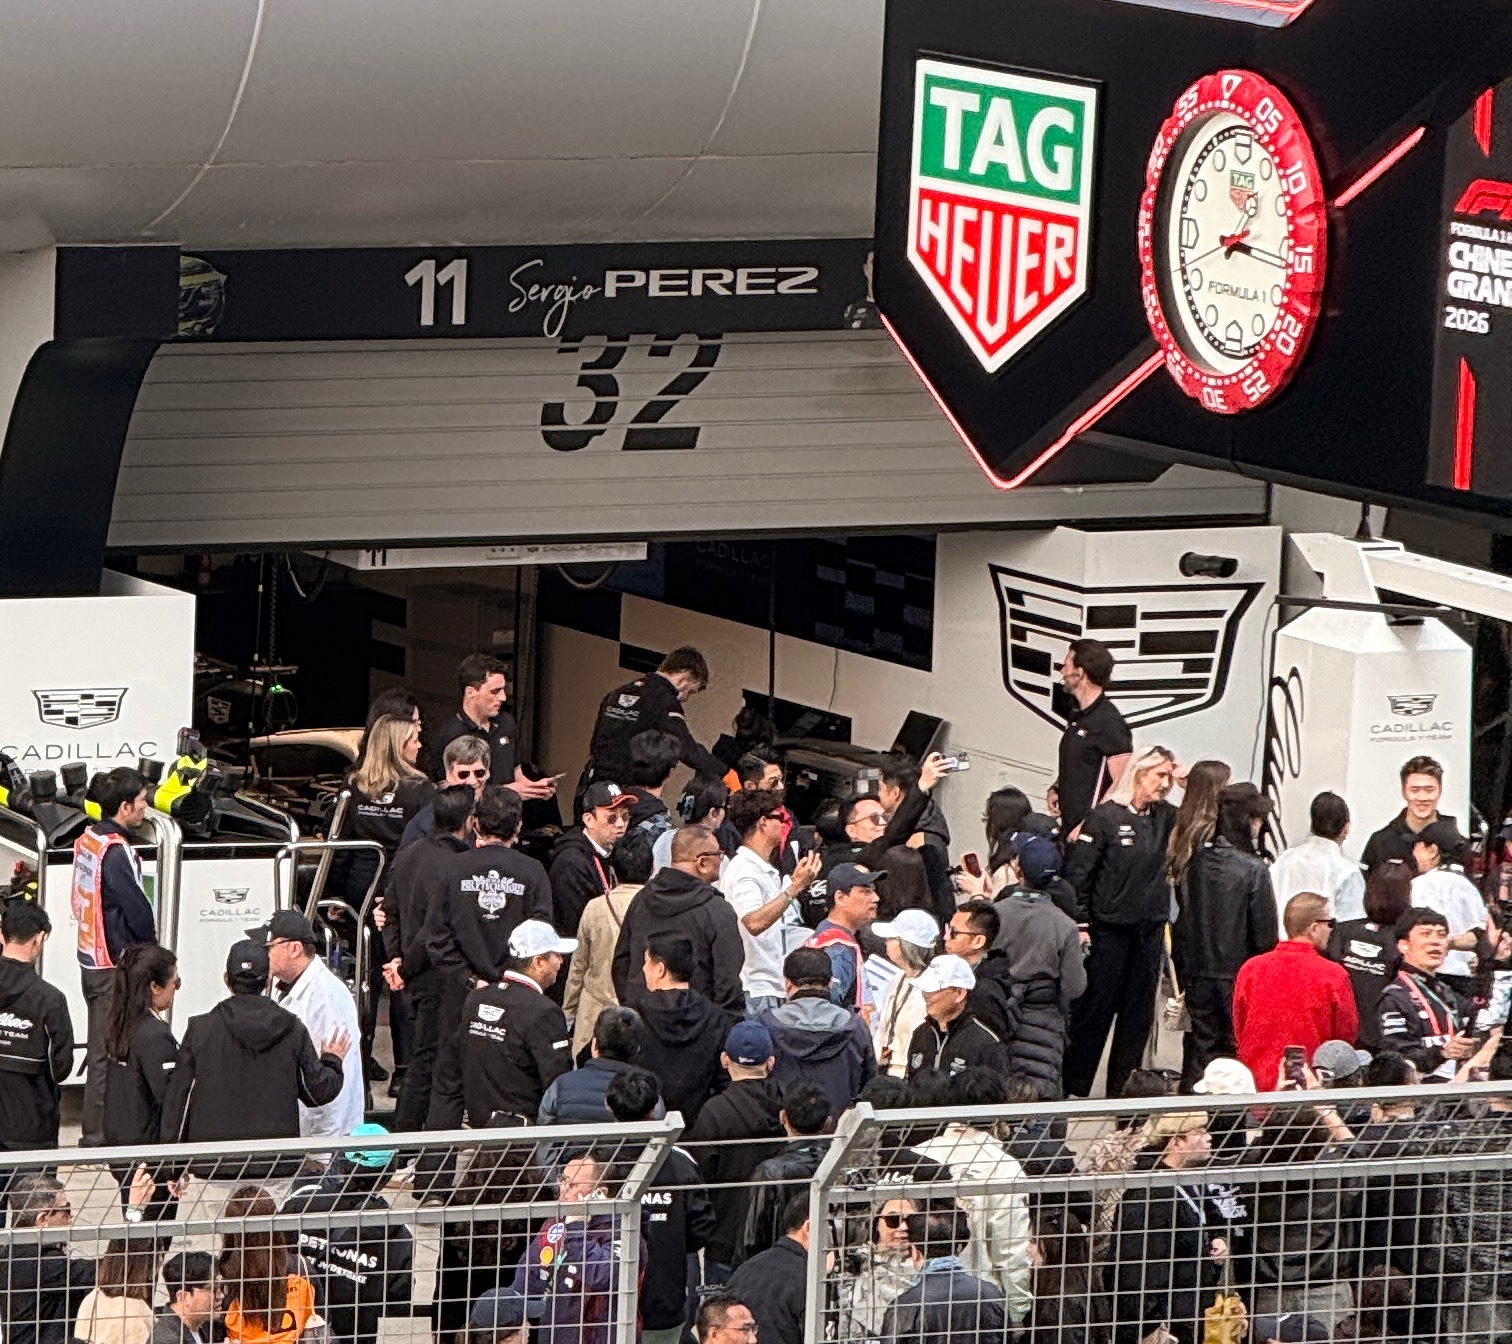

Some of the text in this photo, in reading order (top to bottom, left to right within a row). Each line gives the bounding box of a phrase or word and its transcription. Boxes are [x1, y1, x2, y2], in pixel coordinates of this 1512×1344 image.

[1255, 97, 1284, 134] 05
[929, 87, 1074, 191] TAG
[1286, 161, 1308, 195] 10
[921, 199, 1075, 341] HEUER
[1294, 244, 1314, 274] 15
[404, 258, 819, 338] 11 Sergio PEREZ
[1208, 280, 1259, 300] FORMULA
[1275, 313, 1303, 357] 20
[1444, 306, 1490, 334] 2026
[541, 333, 724, 452] 32
[1242, 370, 1271, 403] 25
[1370, 721, 1453, 734] CADILLAC
[0, 741, 158, 761] CADILLAC
[199, 908, 261, 916] CADILLAC
[4, 1030, 29, 1040] TEAM
